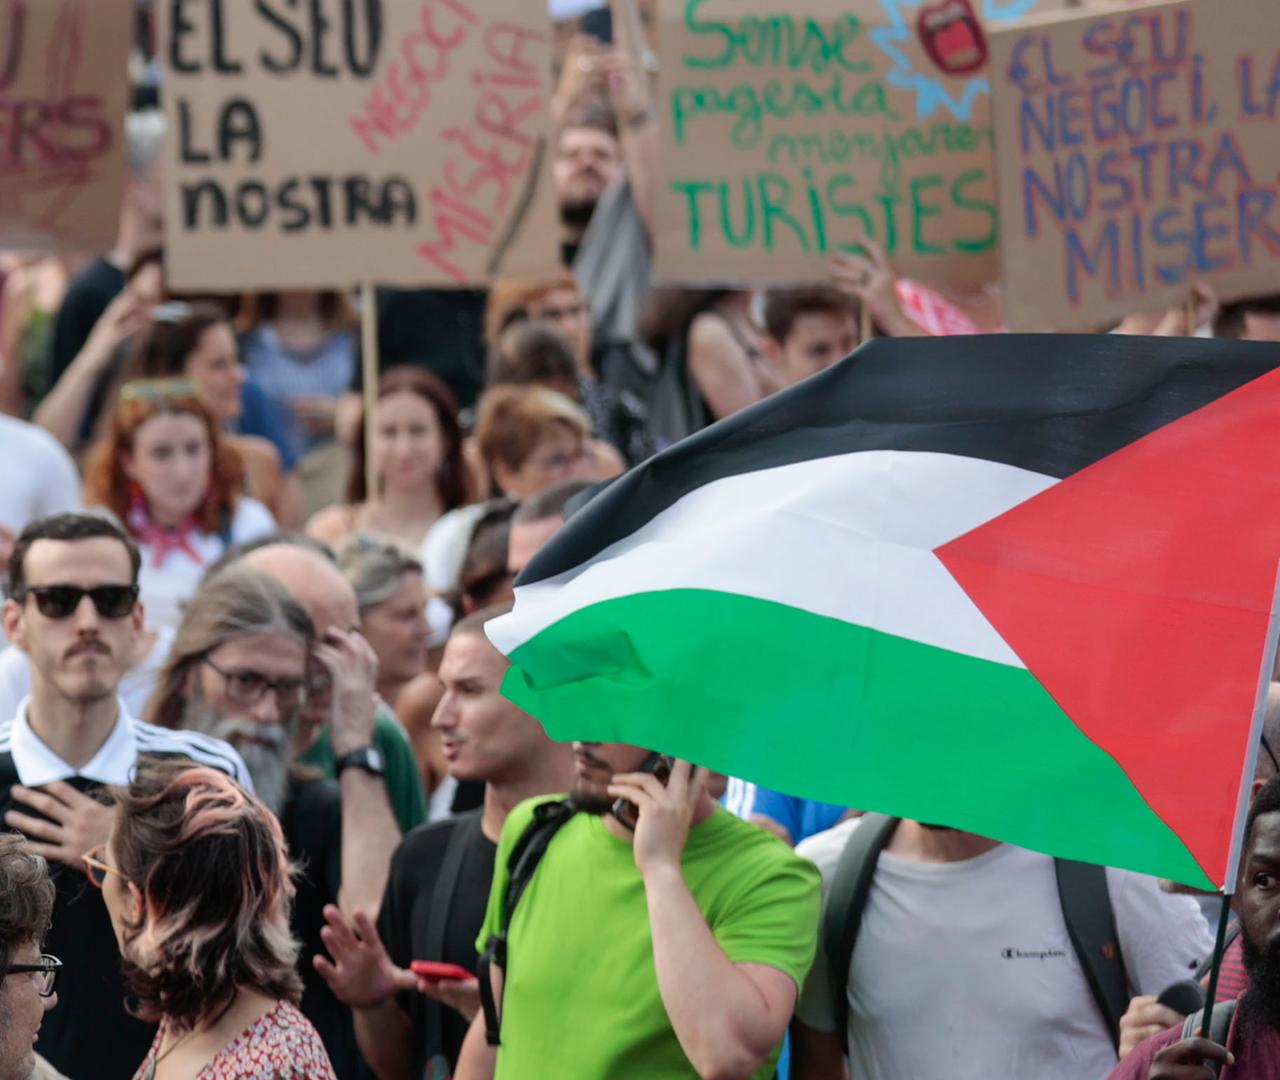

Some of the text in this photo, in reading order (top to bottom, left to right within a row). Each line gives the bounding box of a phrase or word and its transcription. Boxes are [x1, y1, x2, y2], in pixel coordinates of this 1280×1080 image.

[169, 0, 383, 79] EL SEU
[1006, 9, 1191, 92] EL SEU
[176, 95, 264, 165] LA
[1023, 130, 1256, 241] NOSTRA
